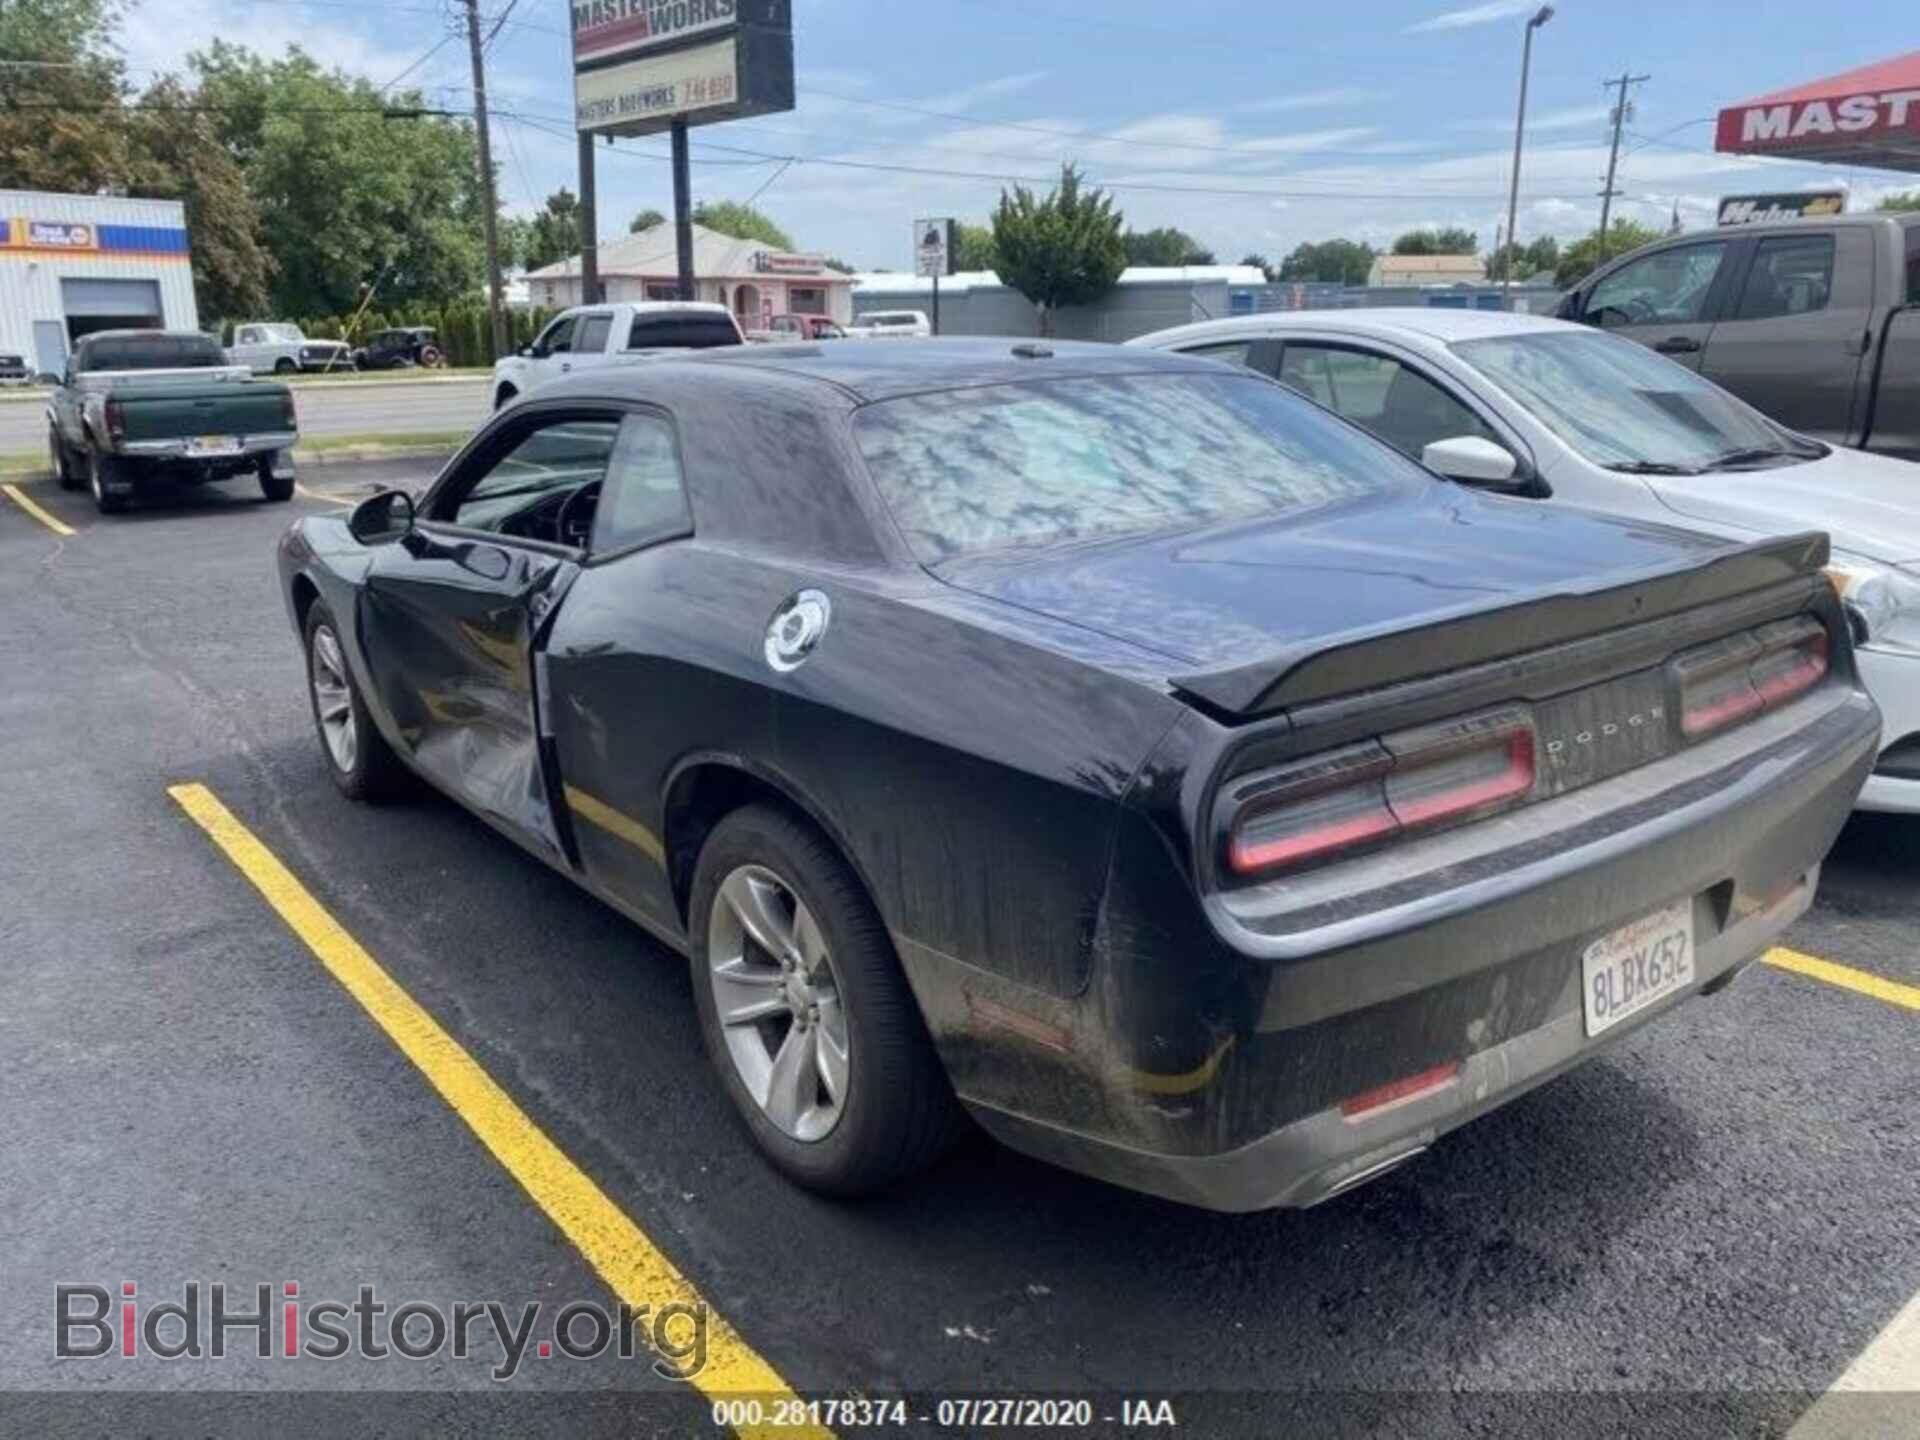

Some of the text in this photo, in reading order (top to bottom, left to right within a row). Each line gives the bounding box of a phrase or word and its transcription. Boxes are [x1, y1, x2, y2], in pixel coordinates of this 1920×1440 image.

[577, 0, 668, 29] MASTE
[651, 0, 735, 35] WORKS
[1742, 91, 1920, 142] MAST
[1593, 930, 1687, 1017] 8LBX652
